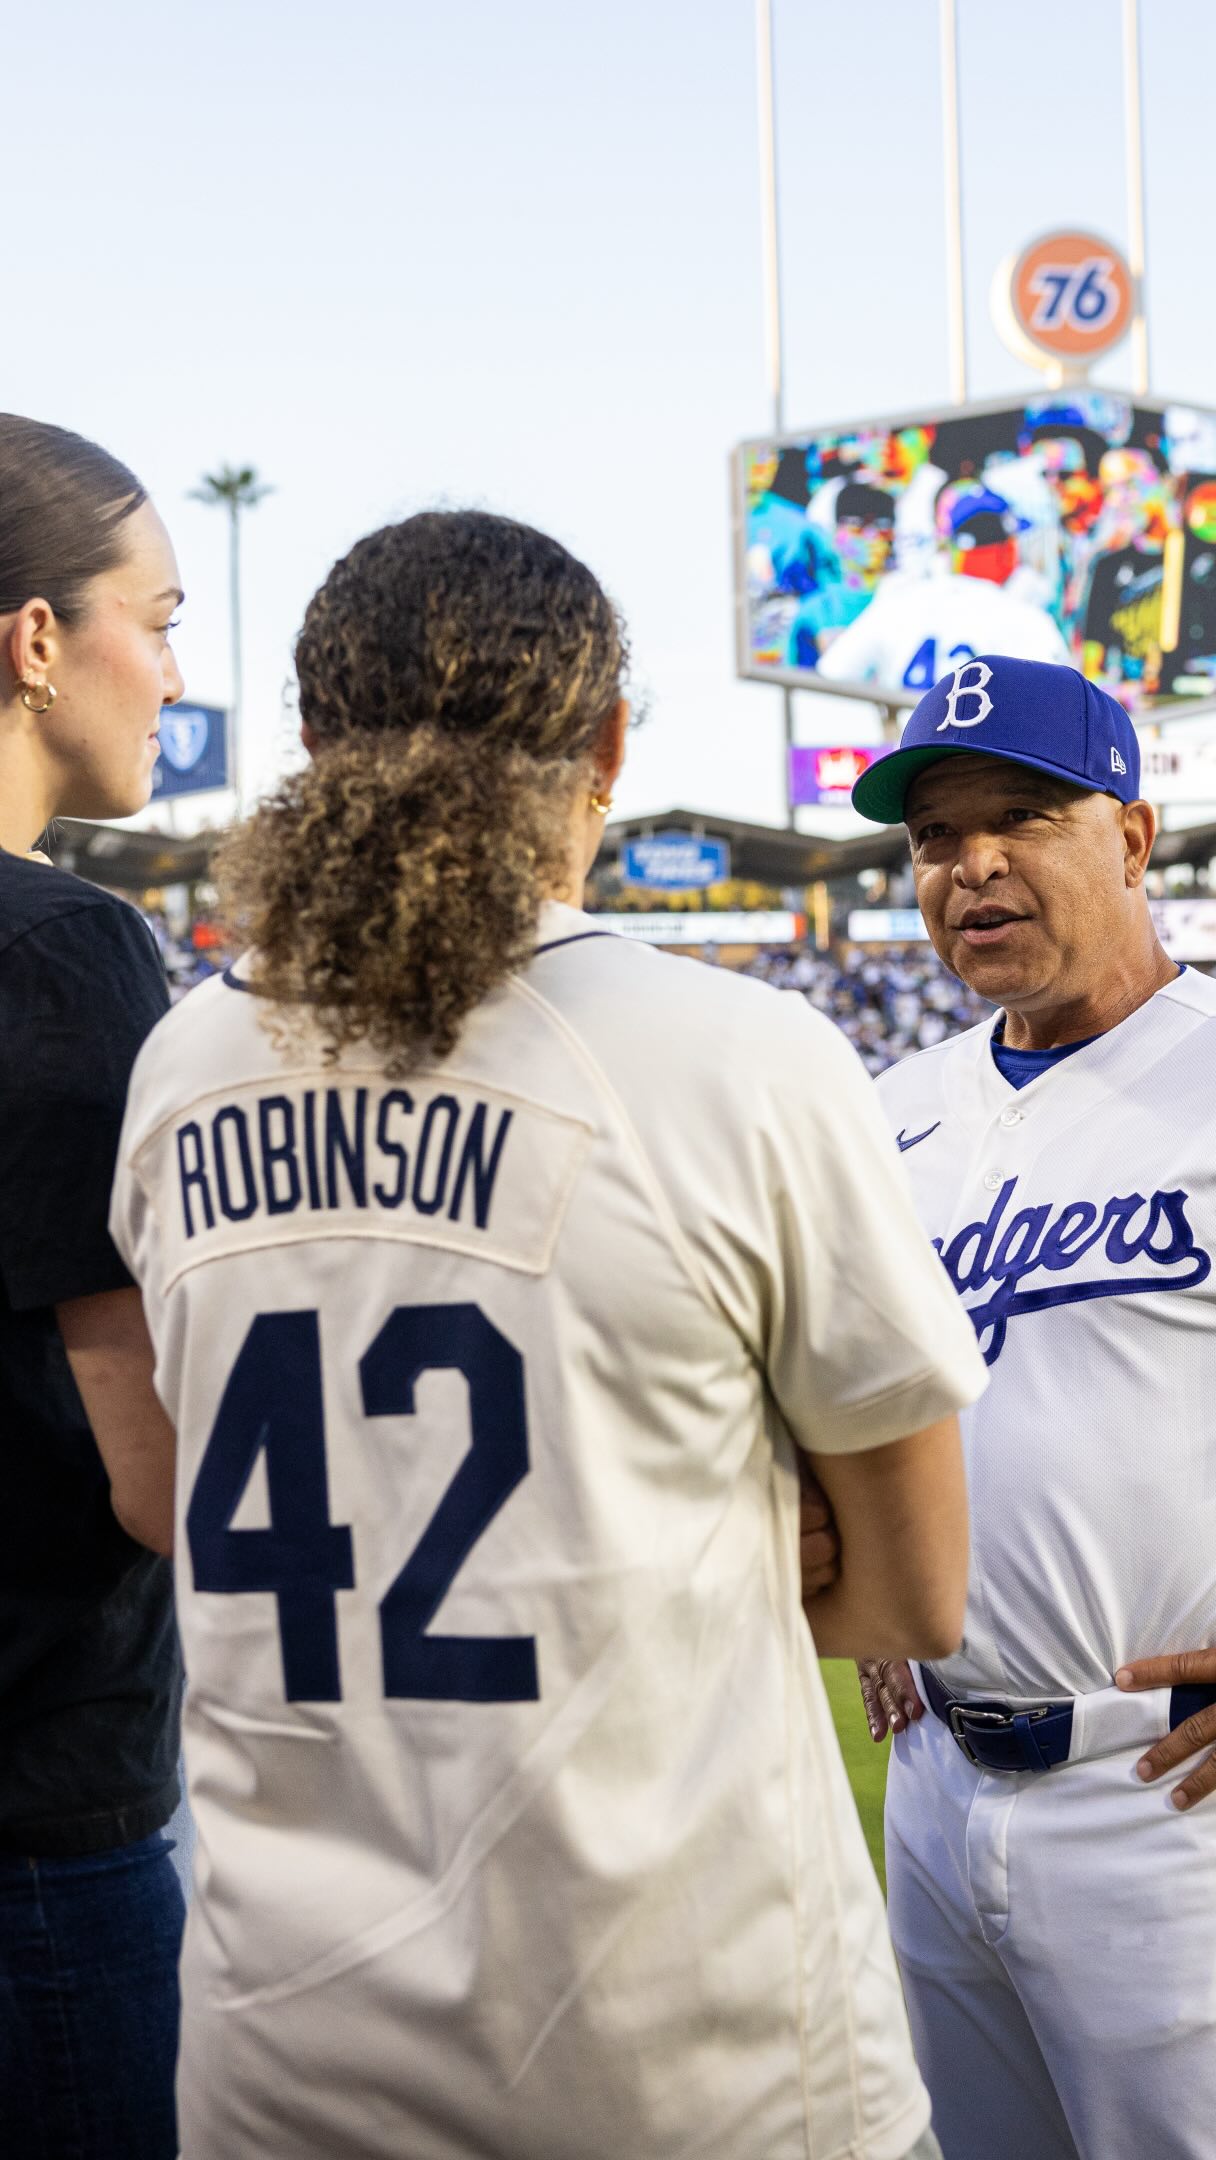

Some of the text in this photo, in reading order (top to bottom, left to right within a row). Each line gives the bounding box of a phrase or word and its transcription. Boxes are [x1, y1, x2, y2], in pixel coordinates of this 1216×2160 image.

[1036, 262, 1113, 328] 76
[903, 638, 976, 689] 4
[936, 661, 994, 732] B
[176, 1087, 513, 1239] ROBINSON
[931, 1174, 1211, 1367] dgers
[186, 1302, 541, 1703] 42
